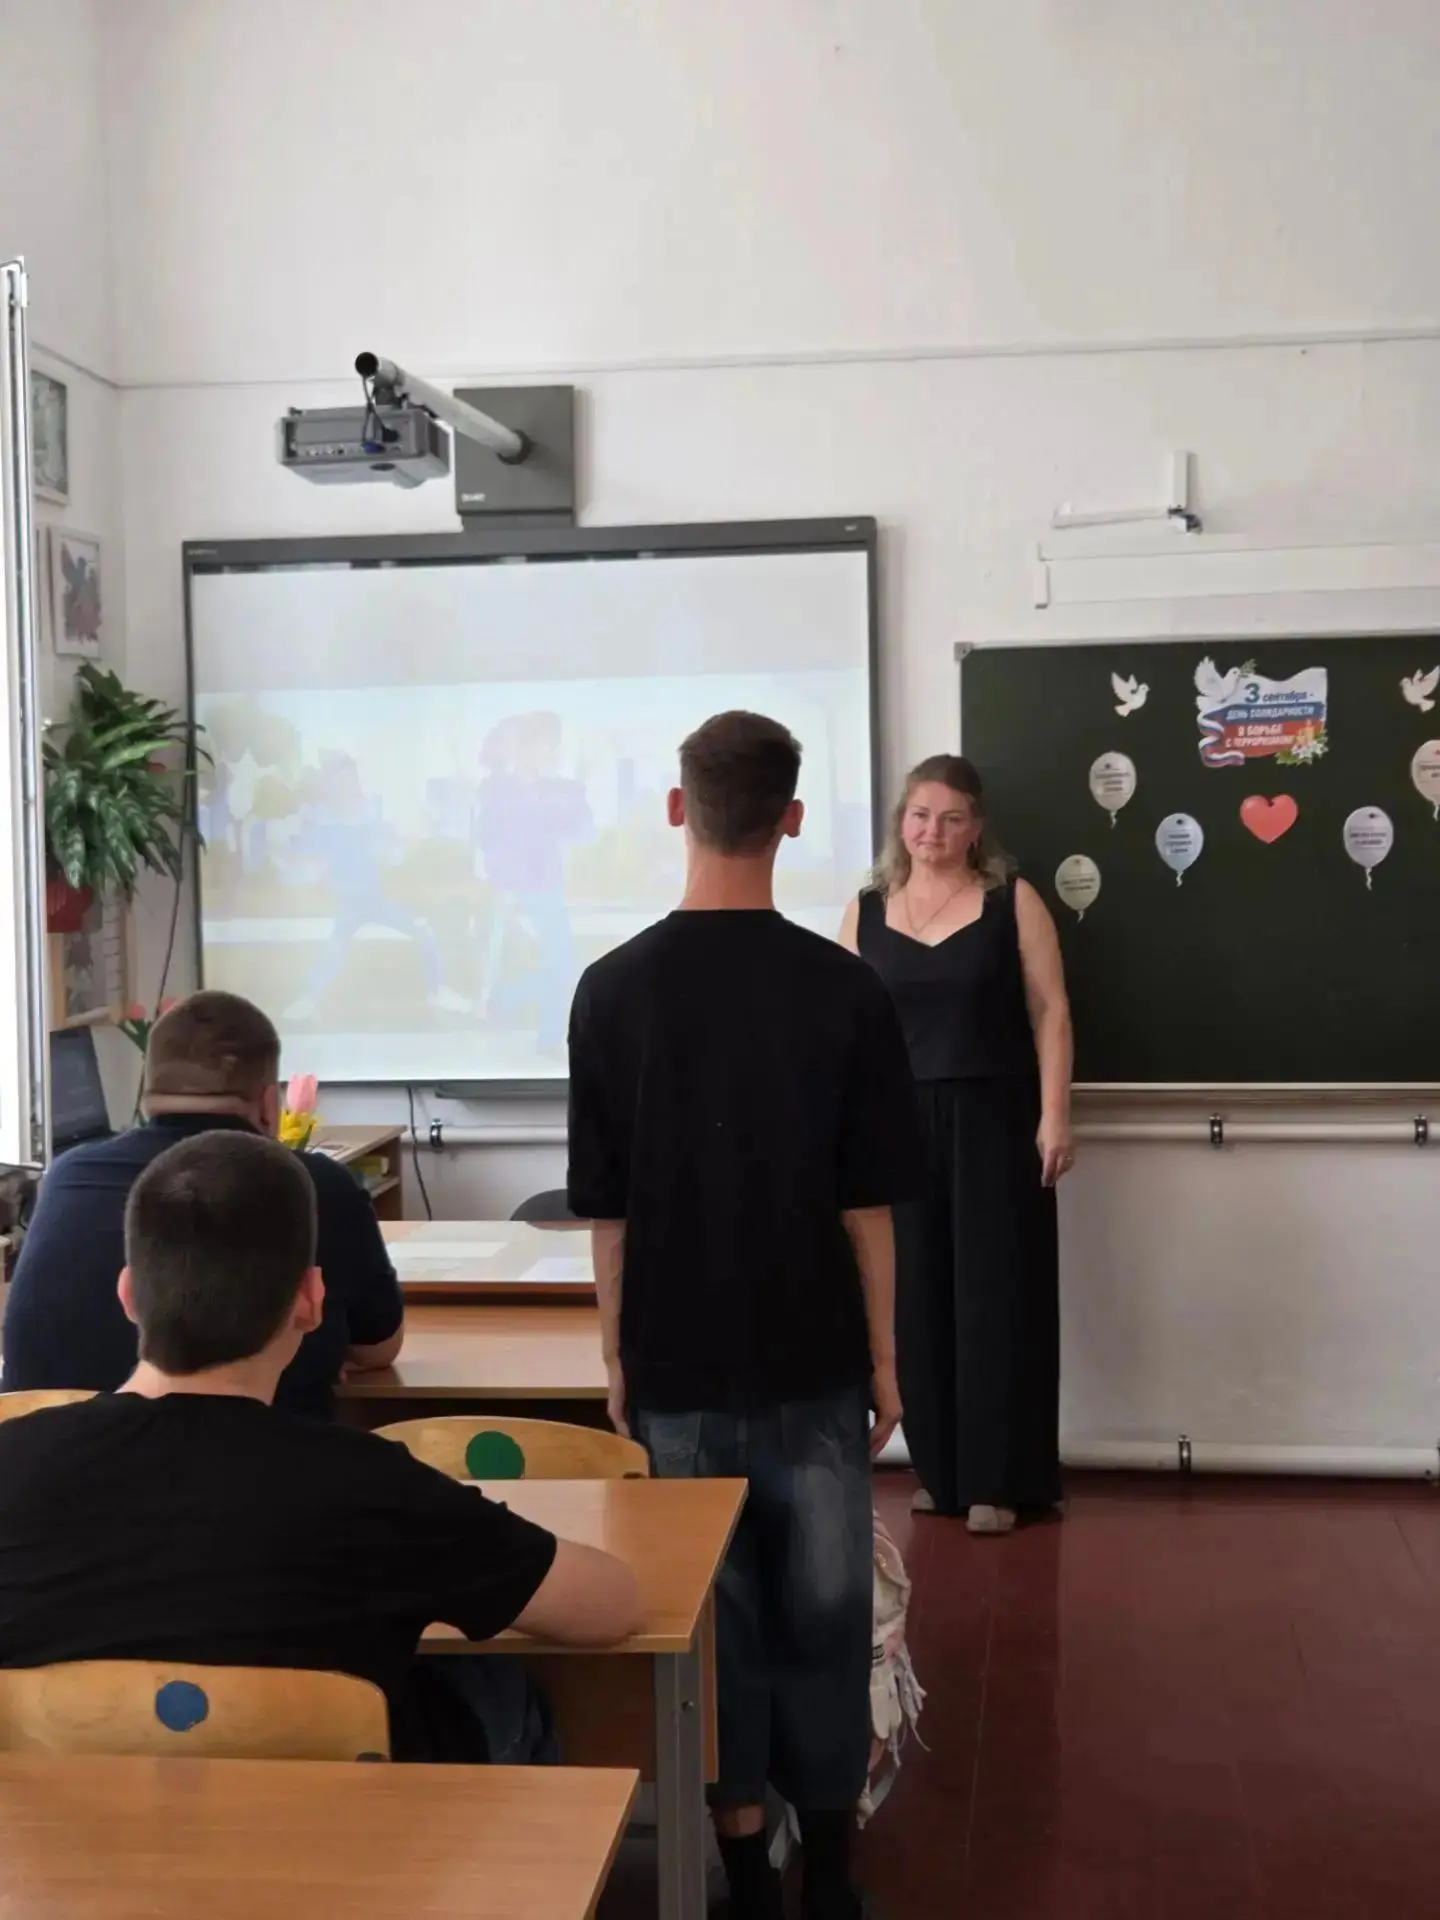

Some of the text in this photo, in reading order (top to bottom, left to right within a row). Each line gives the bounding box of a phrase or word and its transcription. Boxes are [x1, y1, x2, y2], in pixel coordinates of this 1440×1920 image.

[1244, 683, 1260, 703] 3
[1263, 691, 1308, 703] сентября
[1226, 709, 1248, 721] ДЕНЬ
